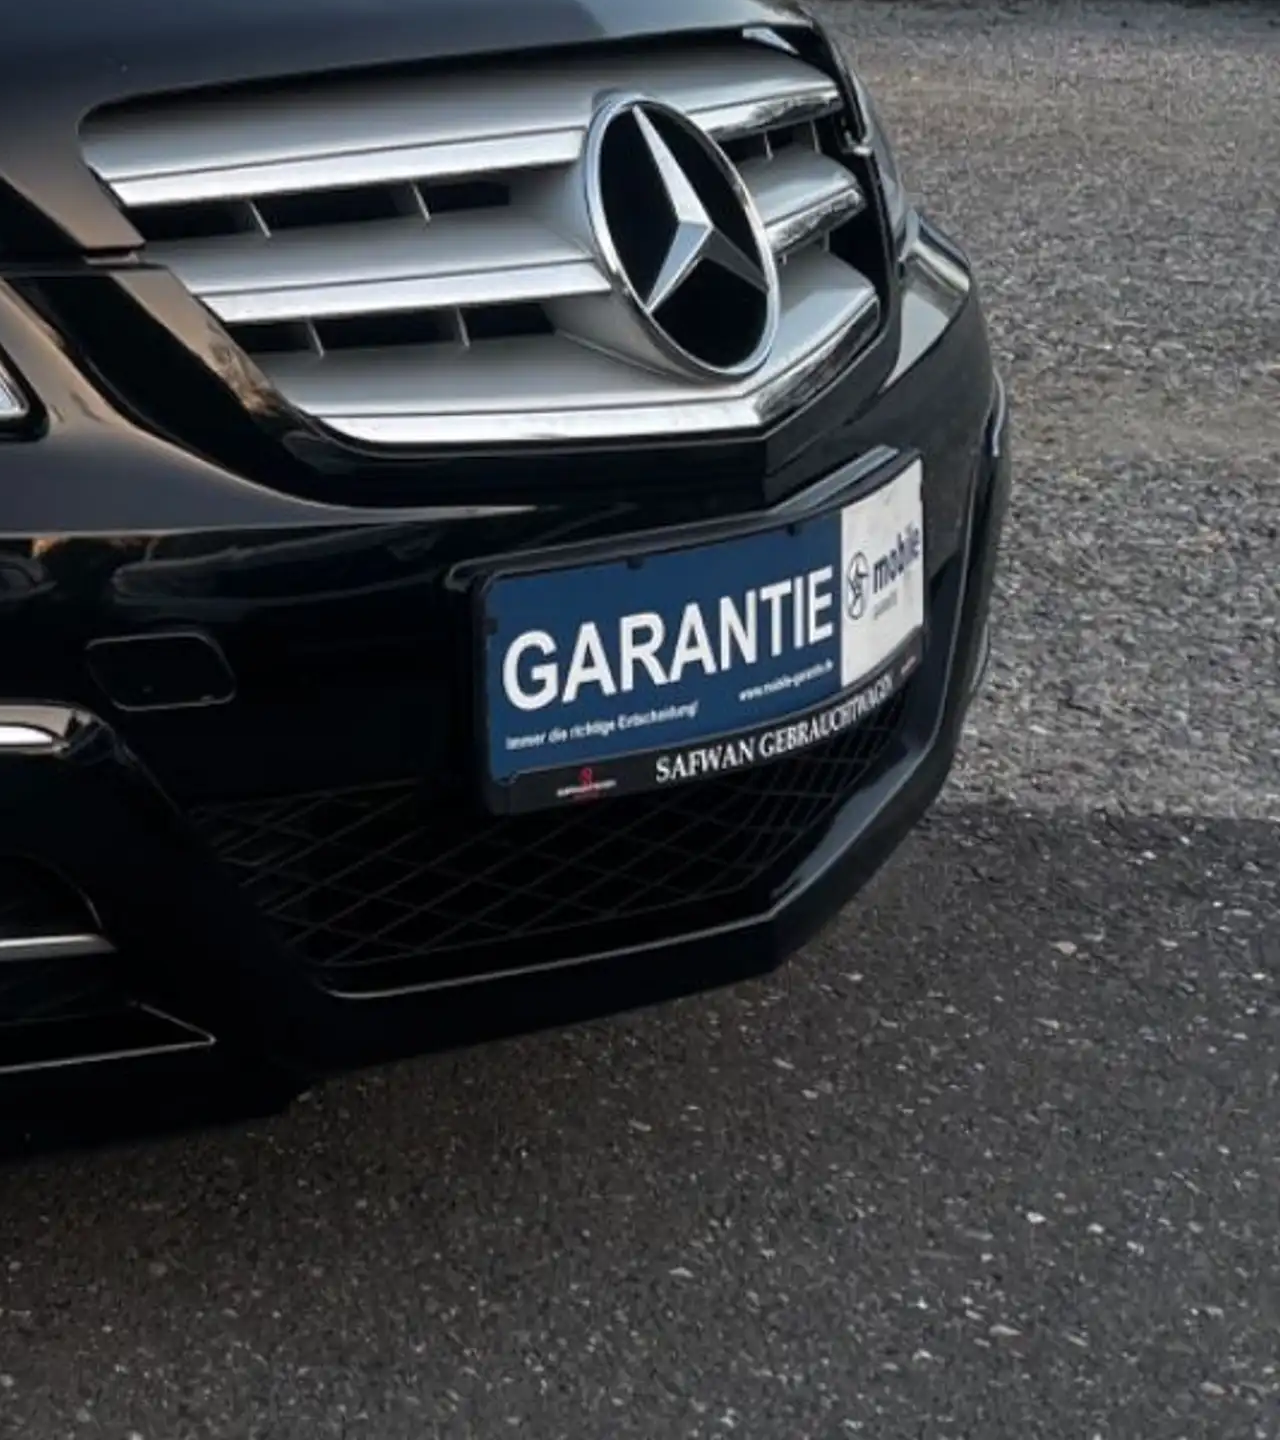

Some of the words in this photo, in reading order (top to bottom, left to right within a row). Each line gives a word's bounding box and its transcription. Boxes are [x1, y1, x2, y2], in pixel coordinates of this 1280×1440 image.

[871, 520, 920, 594] mobile
[503, 565, 834, 710] GARANTIE
[654, 735, 755, 784] SAFWAN
